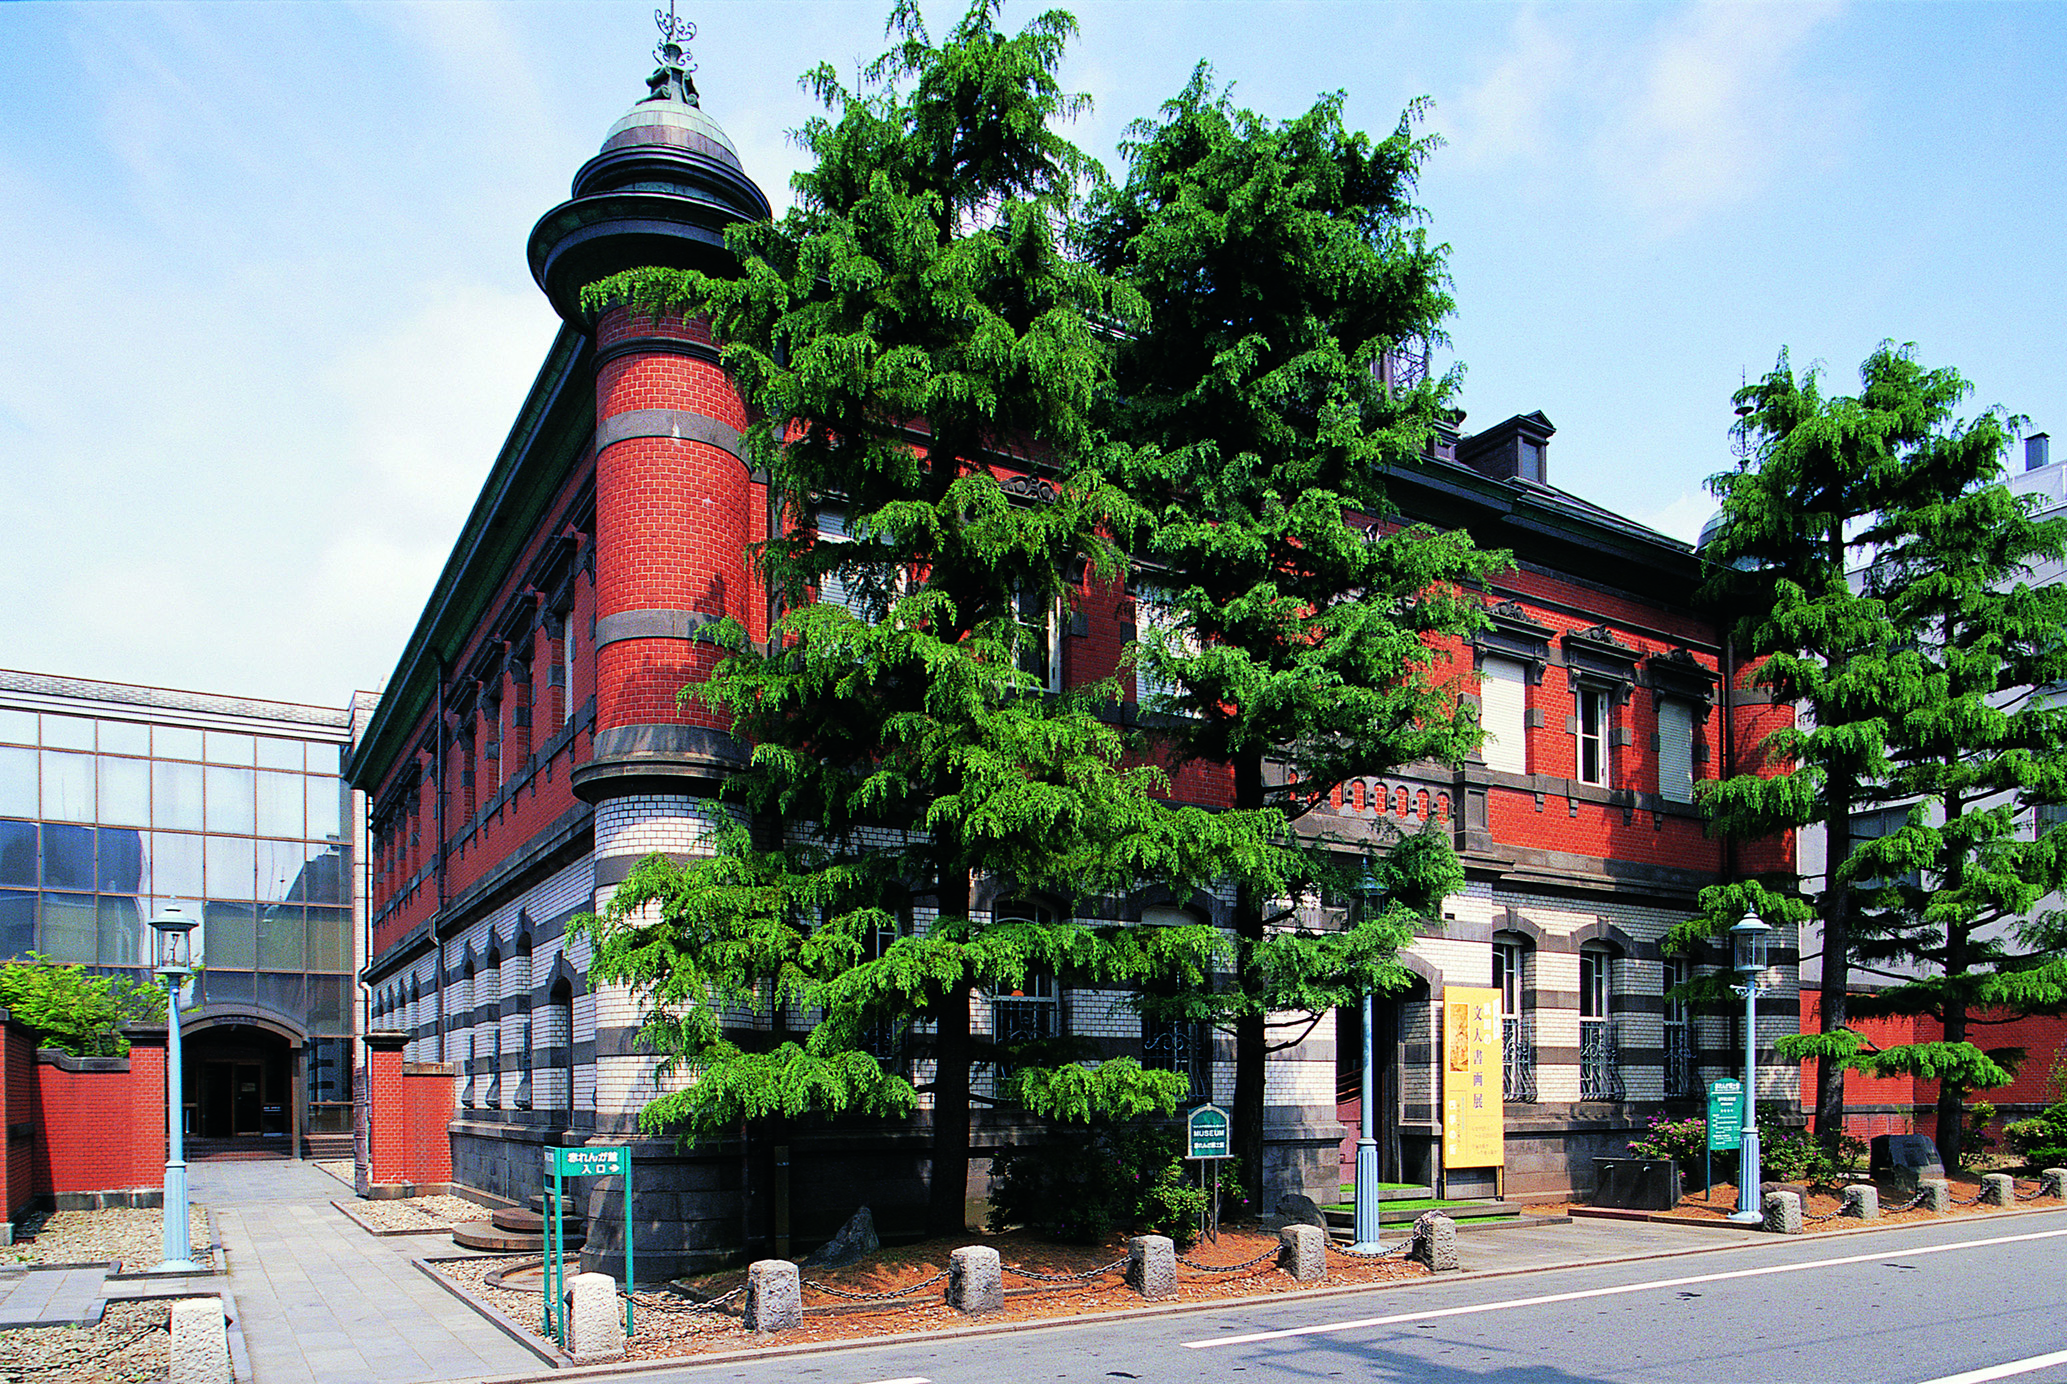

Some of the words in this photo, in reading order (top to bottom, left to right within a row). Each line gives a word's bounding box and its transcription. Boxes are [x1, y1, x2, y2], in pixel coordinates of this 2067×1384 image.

[1473, 1006, 1483, 1109] 文人書画展
[581, 1164, 606, 1174] 入口
